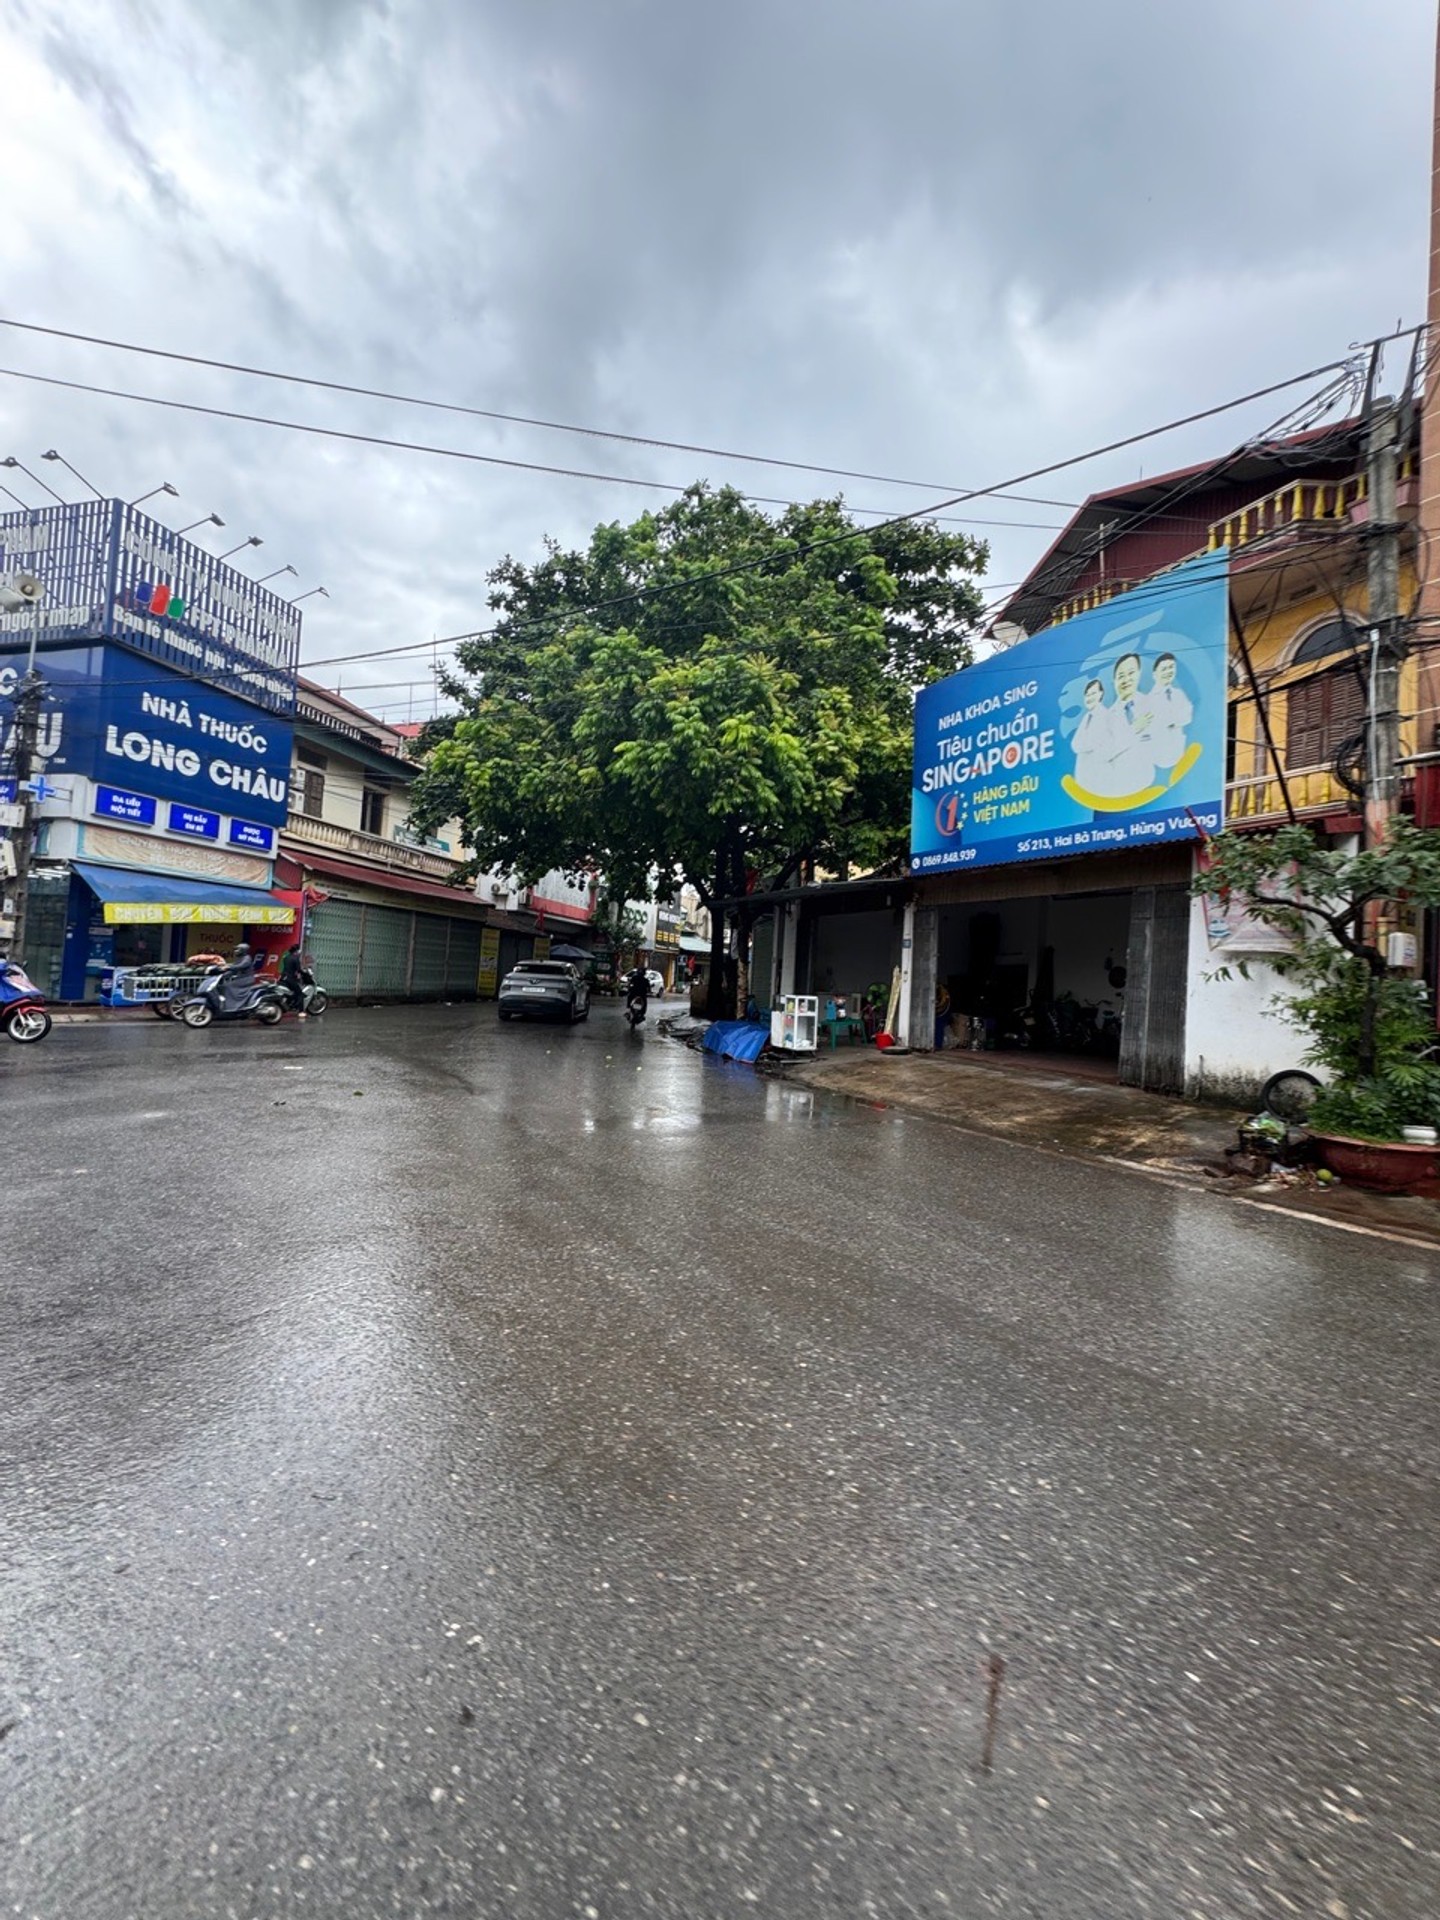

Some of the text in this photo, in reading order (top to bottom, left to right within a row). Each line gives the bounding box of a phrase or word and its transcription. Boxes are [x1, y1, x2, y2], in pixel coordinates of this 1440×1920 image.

[126, 529, 178, 577] CÔNG
[183, 562, 206, 592] TY
[164, 628, 203, 659] thuốc
[204, 647, 225, 670] nội
[190, 606, 287, 669] FPT PHARMA
[142, 691, 268, 754] NHÀ THUỐC
[938, 680, 1038, 731] NHA KHOA SING
[936, 707, 1038, 761] Tiêu chuẩn
[105, 724, 201, 777] LONG
[209, 758, 286, 803] CHÂU
[922, 729, 1055, 793] SINGAPORE
[973, 775, 1040, 805] HÀNG ĐẦU
[973, 799, 1031, 825] VIỆT NAM
[922, 849, 976, 867] 0869.848.939
[1017, 838, 1032, 853] Số
[1032, 837, 1052, 850] 213,
[1054, 833, 1073, 848] Hai
[1074, 830, 1089, 844] Bà
[1091, 827, 1128, 842] Trung,
[1130, 820, 1166, 837] Hùng
